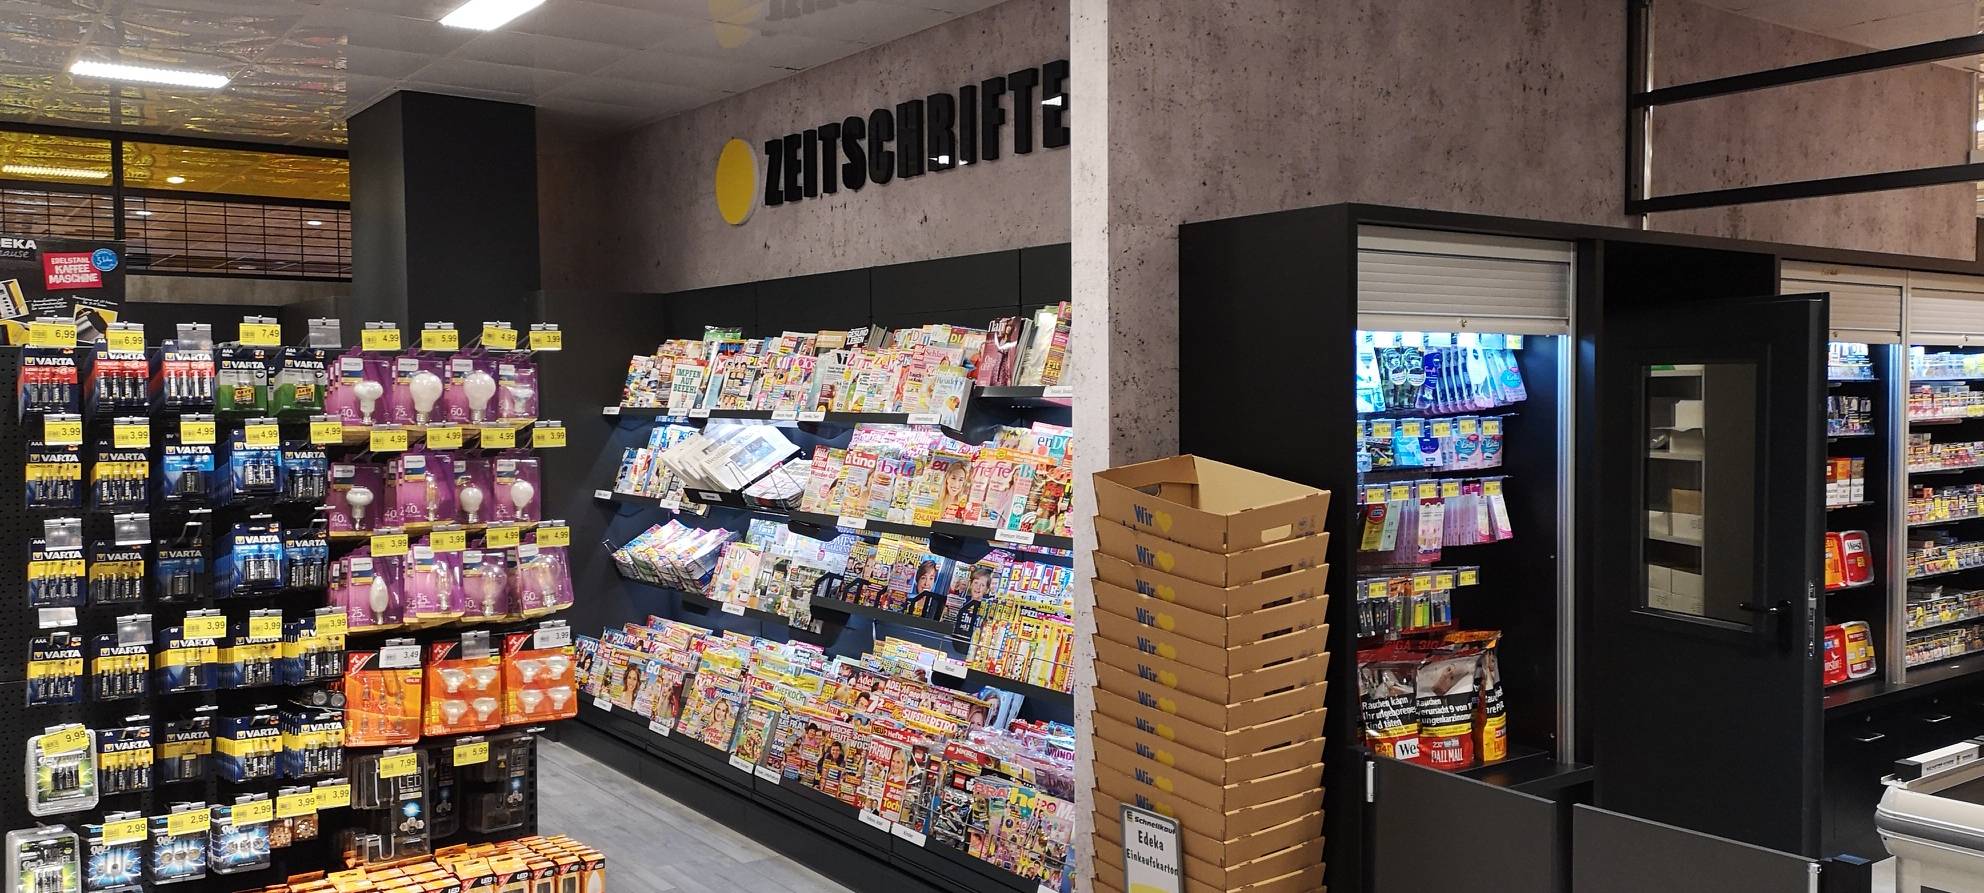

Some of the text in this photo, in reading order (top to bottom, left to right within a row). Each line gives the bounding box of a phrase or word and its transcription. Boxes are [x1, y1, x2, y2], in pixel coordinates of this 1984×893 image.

[54, 264, 91, 274] KAFFEE
[48, 272, 99, 284] MASCHINE
[55, 329, 76, 340] 6,99
[261, 328, 280, 339] 7,49
[383, 333, 399, 342] 4,99
[441, 333, 457, 343] 5,99
[500, 333, 516, 342] 4,99
[124, 335, 144, 346] 6,99
[35, 358, 75, 366] VARTA
[231, 361, 265, 369] VARTA
[294, 360, 324, 369] VARTA
[450, 407, 462, 416] 60
[61, 427, 81, 437] 3,99
[129, 430, 149, 440] 3,99
[196, 426, 214, 436] 4,99
[325, 426, 342, 435] 4,99
[445, 431, 461, 440] 4,99
[500, 431, 514, 440] 4,99
[550, 431, 565, 440] 3,99
[260, 431, 278, 441] 4,99
[389, 434, 407, 443] 4,99
[176, 446, 212, 454] VARTA
[41, 454, 79, 462] VARTA
[110, 453, 147, 461] VARTA
[1133, 504, 1153, 527] Wir
[449, 534, 465, 543] 3,99
[504, 529, 519, 539] 4,99
[554, 529, 569, 539] 4,99
[245, 536, 280, 544] VARTA
[390, 538, 408, 548] 3,99
[44, 550, 83, 559] VARTA
[106, 553, 142, 561] VARTA
[169, 550, 203, 558] VARTA
[1135, 544, 1155, 566] Wir
[1135, 578, 1155, 597] Wir
[1135, 606, 1155, 627] Wir
[207, 621, 225, 631] 3,99
[263, 621, 281, 631] 3,99
[330, 618, 347, 629] 3,99
[180, 638, 215, 647] VARTA
[1137, 636, 1157, 656] Wir
[44, 649, 82, 659] VARTA
[110, 646, 147, 655] VARTA
[403, 649, 419, 660] 3,49
[1137, 664, 1157, 683] Wir
[1138, 691, 1157, 709] Wir
[1361, 696, 1409, 710] Rauchen kann
[1449, 704, 1455, 713] 9
[1455, 704, 1467, 712] von
[311, 721, 342, 732] VARTA
[1135, 716, 1155, 734] Wir
[65, 731, 86, 742] 9,99
[177, 731, 210, 741] VARTA
[246, 728, 280, 738] VARTA
[114, 740, 151, 749] VARTA
[473, 748, 489, 757] 5,99
[1135, 742, 1156, 760] Wir
[400, 758, 417, 768] 7,99
[399, 774, 422, 789] LED
[1135, 768, 1154, 786] Wir
[332, 790, 350, 800] 3,99
[298, 798, 316, 808] 3,99
[253, 804, 271, 816] 2,99
[190, 813, 210, 824] 2,99
[127, 823, 147, 834] 2,99
[1138, 830, 1164, 851] Edeka
[1126, 848, 1179, 876] Einkaufskarton
